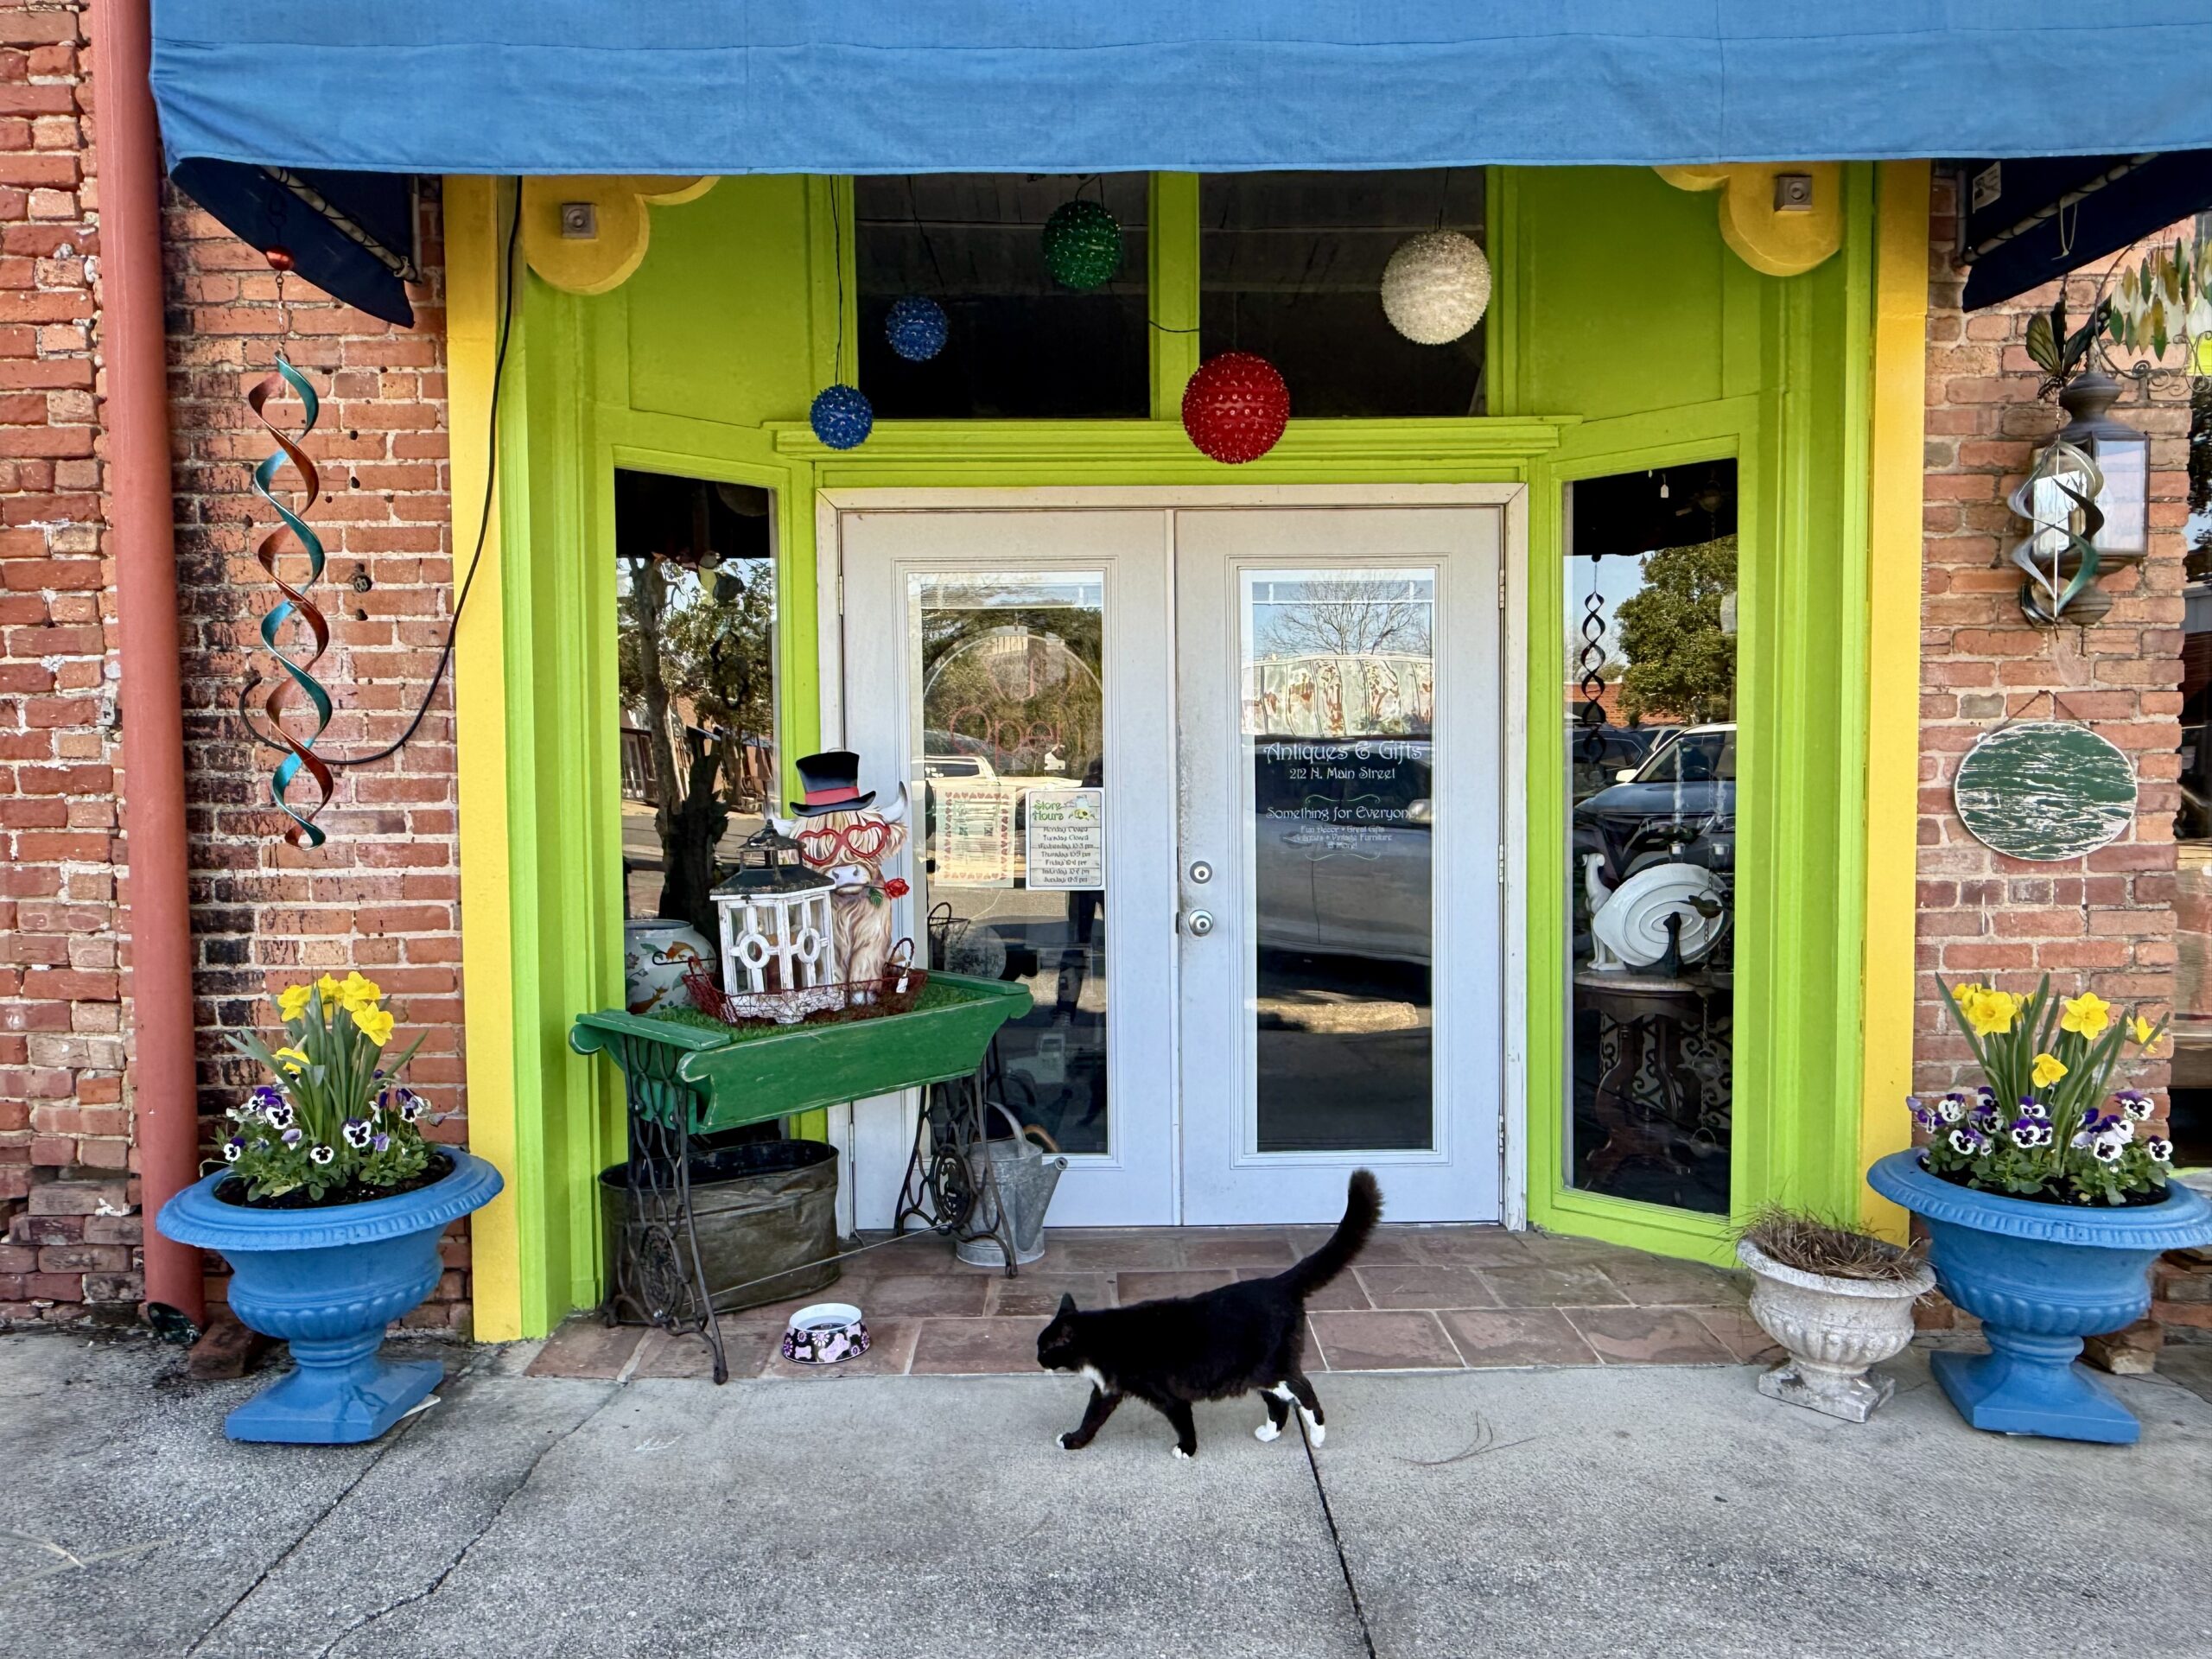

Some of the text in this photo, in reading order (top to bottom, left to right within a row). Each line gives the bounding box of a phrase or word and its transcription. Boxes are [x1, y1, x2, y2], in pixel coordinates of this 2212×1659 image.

[1263, 740, 1422, 765] Antiques & Gifts
[1289, 766, 1395, 780] 212 N. Main Street
[1033, 799, 1062, 810] Store
[1033, 811, 1065, 821] Hours
[1266, 806, 1329, 821] Something
[1333, 806, 1353, 821] for
